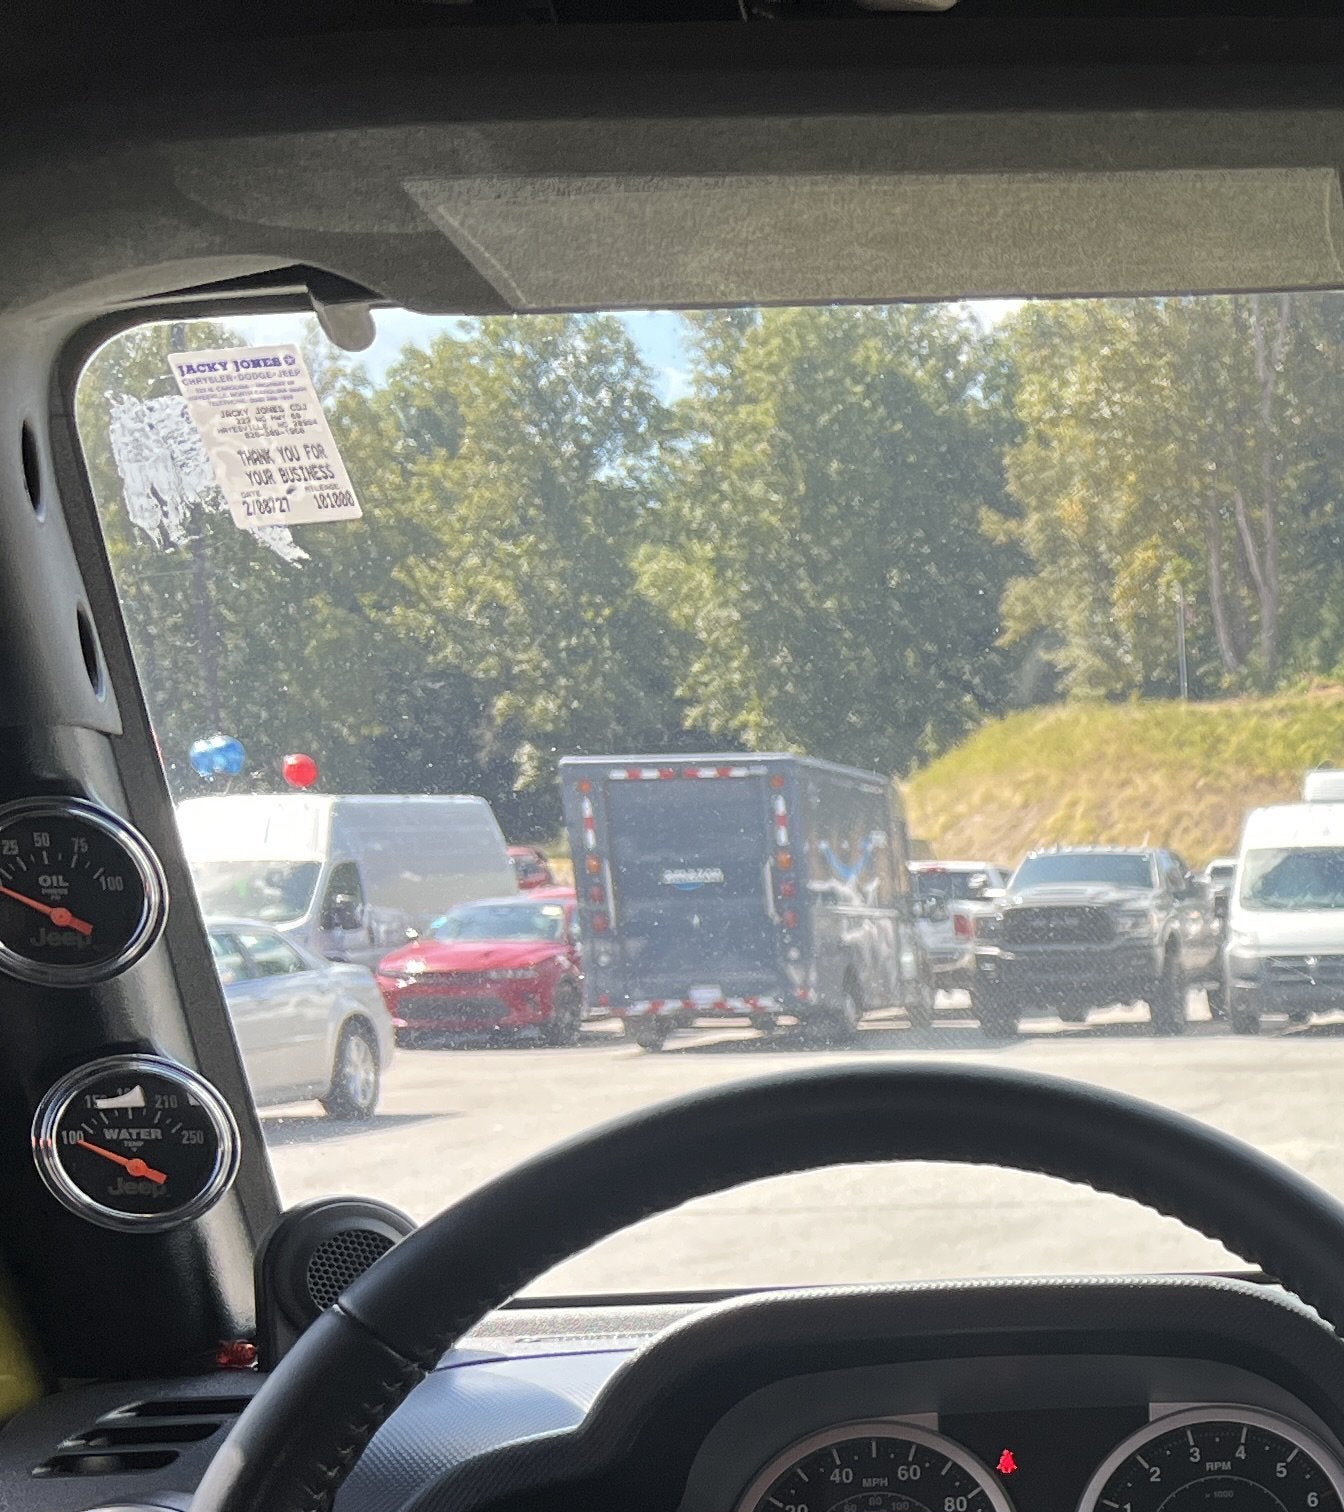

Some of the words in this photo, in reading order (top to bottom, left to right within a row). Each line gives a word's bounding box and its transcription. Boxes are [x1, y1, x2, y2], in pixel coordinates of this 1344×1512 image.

[178, 361, 228, 376] JACKY
[233, 355, 282, 372] JONES
[221, 408, 249, 419] JACKY
[255, 405, 284, 415] JONES
[237, 448, 275, 466] THANK
[277, 445, 300, 463] YOU
[303, 443, 328, 460] FOR
[245, 467, 276, 486] YOUR
[278, 464, 335, 484] BUSINESS
[2, 840, 19, 855] 25
[71, 838, 88, 853] 75
[33, 832, 50, 847] 50
[38, 875, 69, 887] OIL
[100, 876, 123, 891] 100
[29, 928, 92, 948] Jeep
[155, 1095, 177, 1109] 210
[61, 1130, 84, 1145] 100
[103, 1129, 162, 1139] WATER
[181, 1130, 204, 1145] 250
[108, 1177, 167, 1197] Jeep
[830, 1468, 853, 1484] 40
[898, 1465, 921, 1481] 60
[1206, 1461, 1231, 1472] RPM
[862, 1478, 888, 1488] MPH
[1150, 1467, 1161, 1482] 2
[1189, 1448, 1200, 1463] 3
[1235, 1445, 1246, 1460] 4
[1276, 1462, 1287, 1478] 5
[1307, 1492, 1319, 1507] 6
[1214, 1490, 1234, 1499] 1000
[944, 1497, 967, 1512] 80
